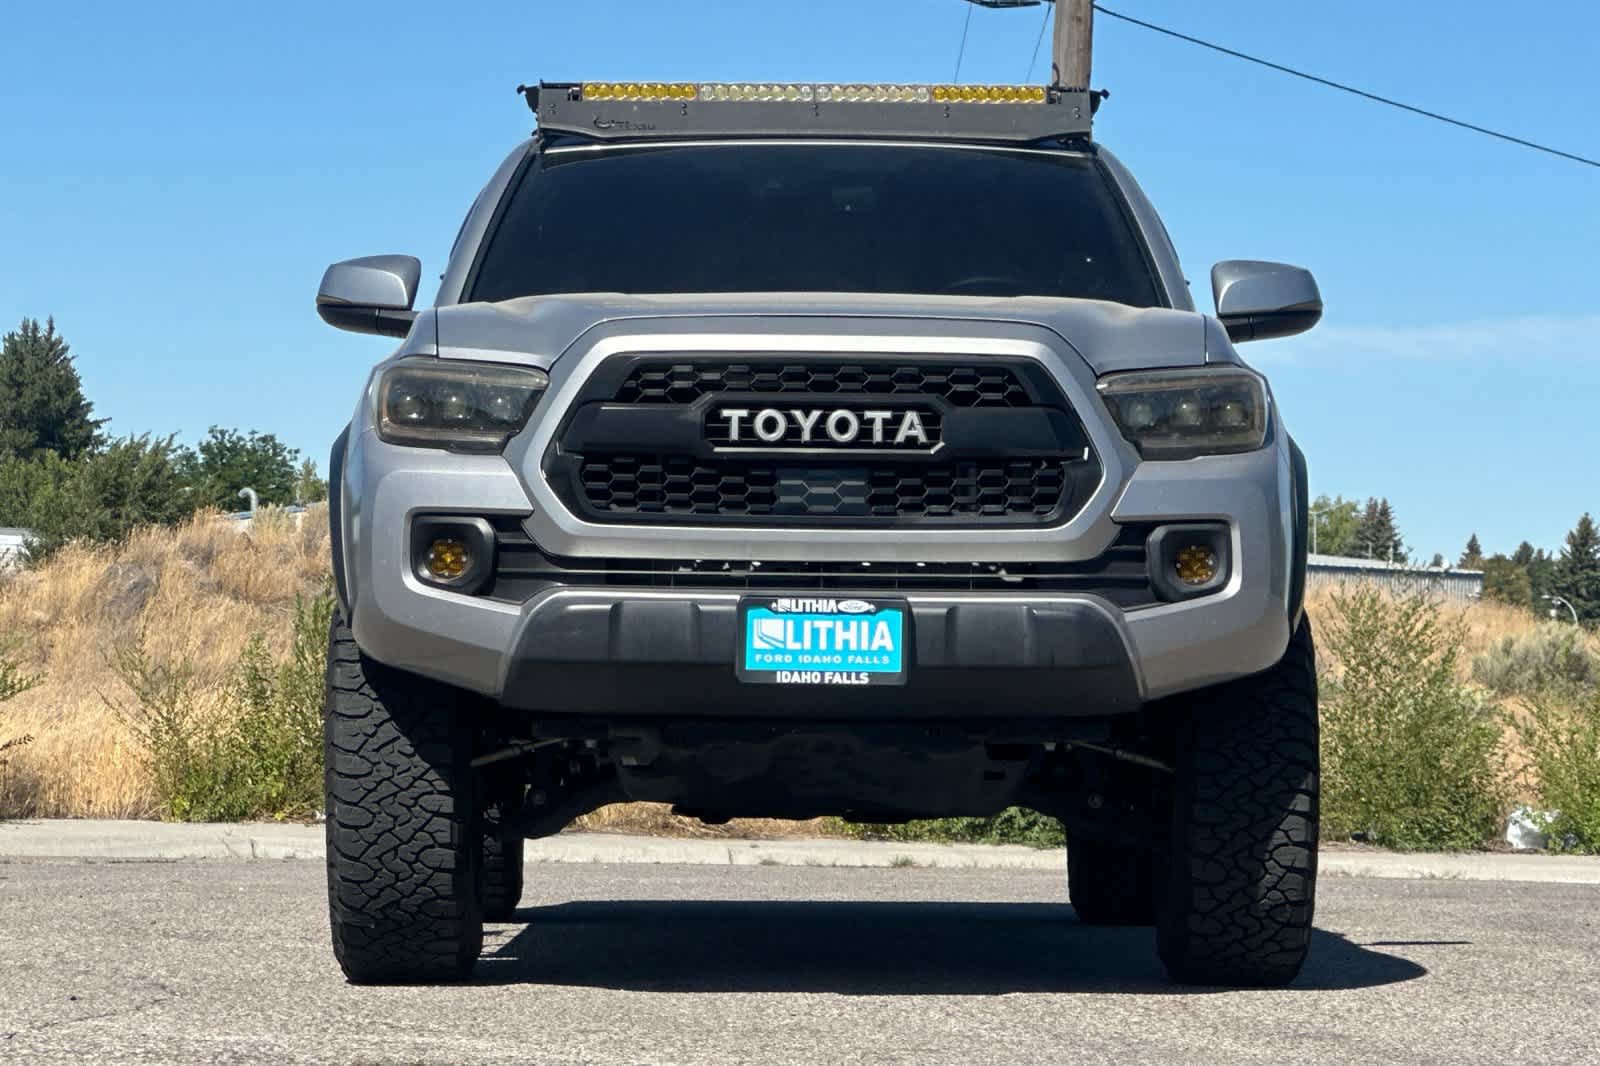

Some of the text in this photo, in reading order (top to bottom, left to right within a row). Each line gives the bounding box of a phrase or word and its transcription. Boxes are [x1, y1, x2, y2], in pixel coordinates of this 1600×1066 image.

[721, 408, 928, 444] TOYOTA
[791, 599, 838, 613] LITHIA
[786, 620, 894, 651] LITHIA
[755, 653, 890, 664] FORD IDAHO FALLS
[776, 671, 869, 684] IDAHO FALLS
